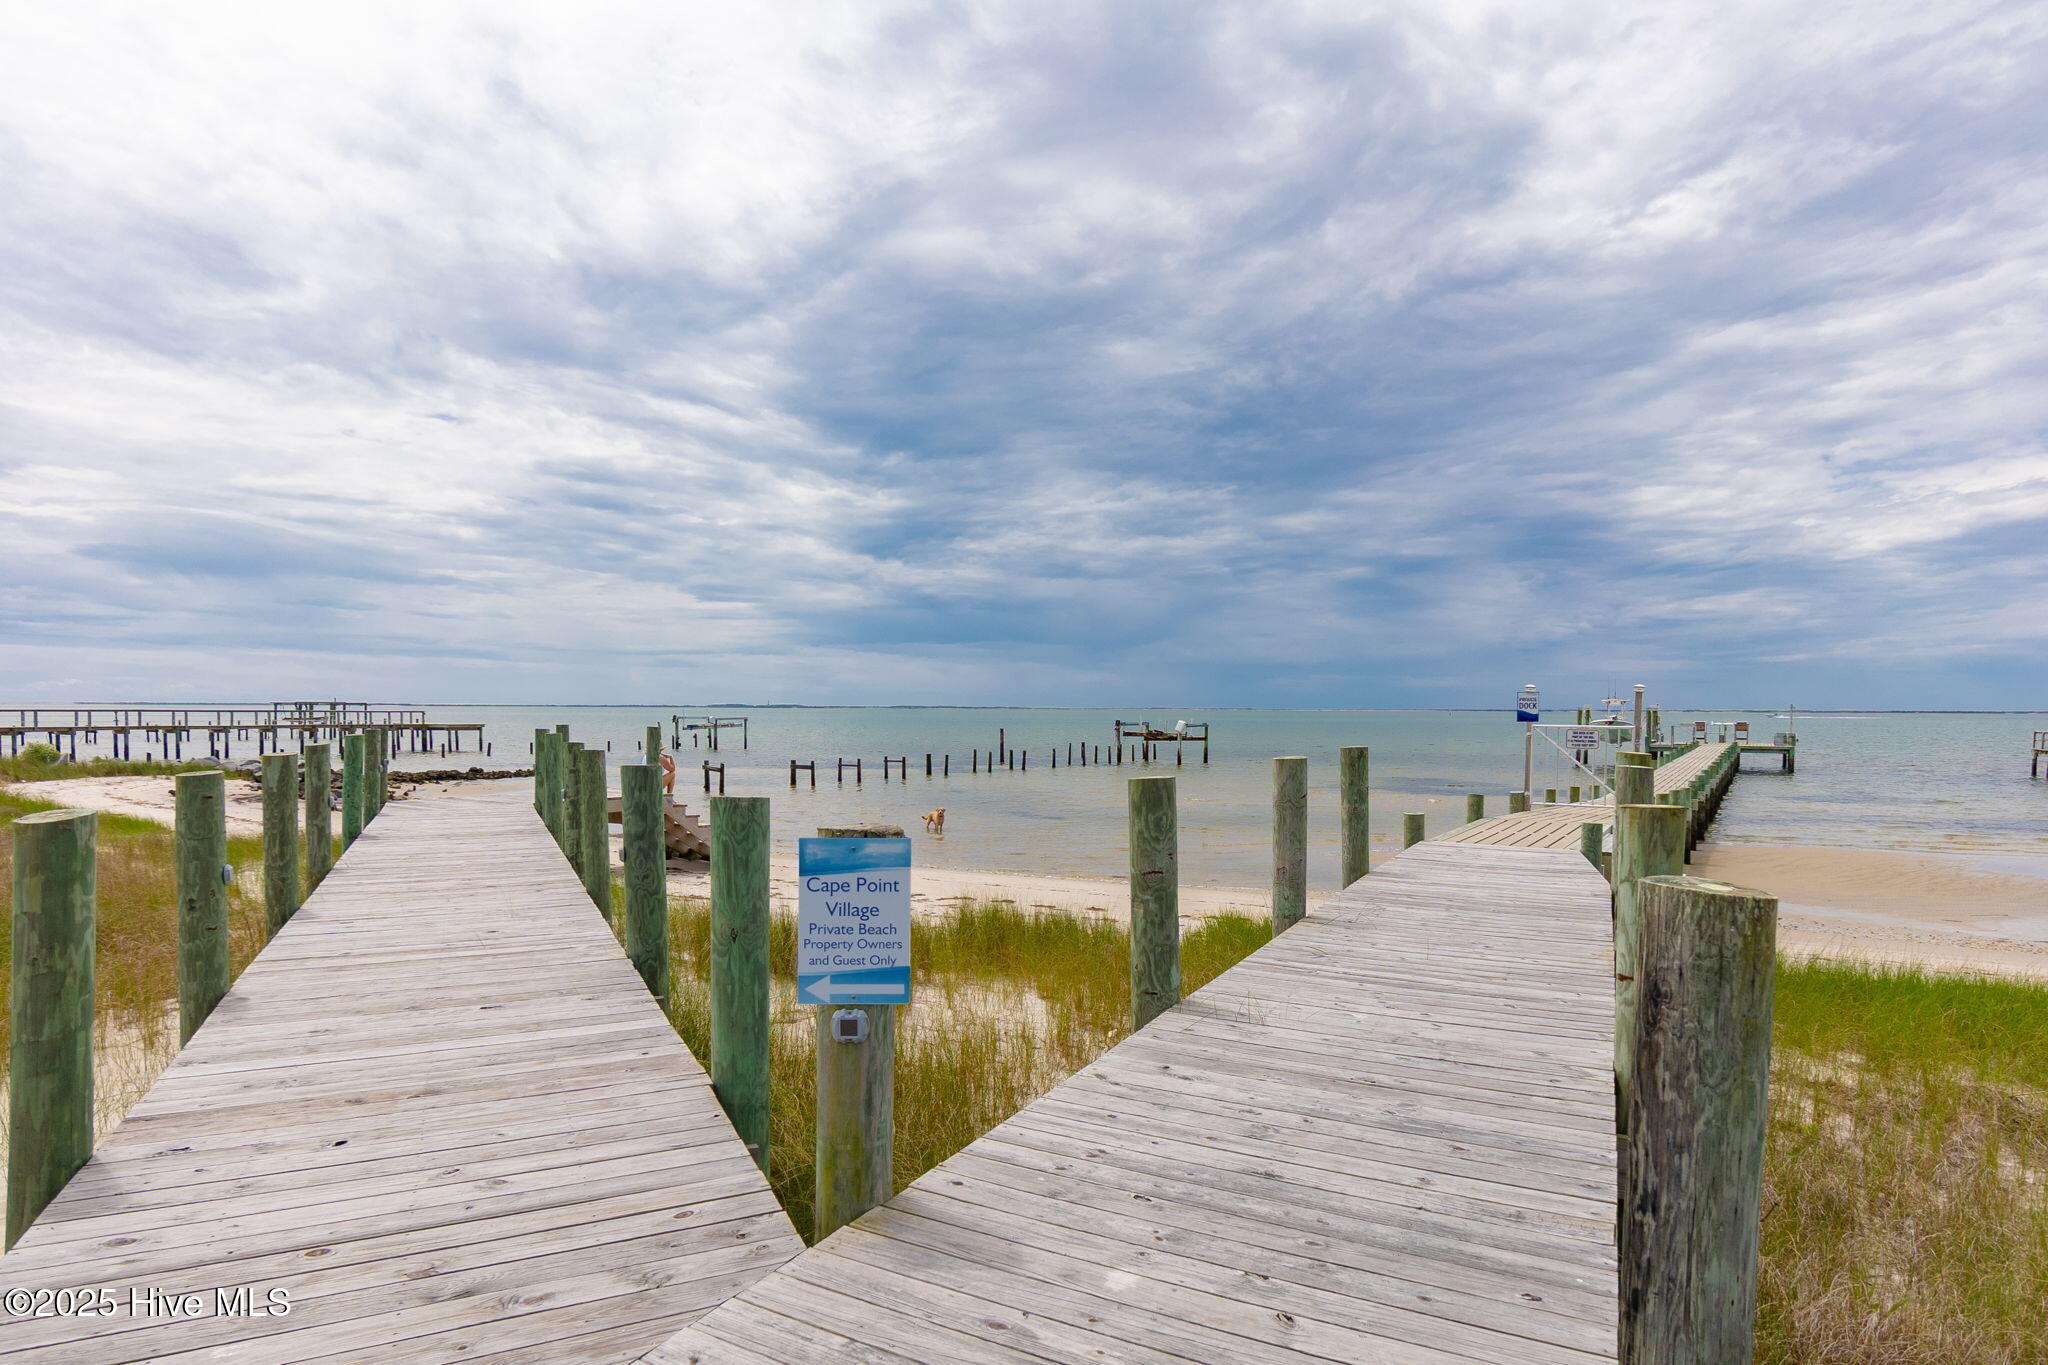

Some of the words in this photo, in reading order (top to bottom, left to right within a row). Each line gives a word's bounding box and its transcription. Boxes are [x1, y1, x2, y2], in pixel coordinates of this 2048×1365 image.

[806, 877, 851, 896] Cape
[857, 877, 900, 893] Point
[825, 901, 880, 920] Village
[809, 923, 854, 935] Private
[859, 923, 897, 935] Beach
[803, 939, 853, 952] Property
[857, 939, 903, 949] Owners
[808, 955, 830, 966] and
[832, 955, 866, 966] Guest
[869, 955, 897, 968] Only
